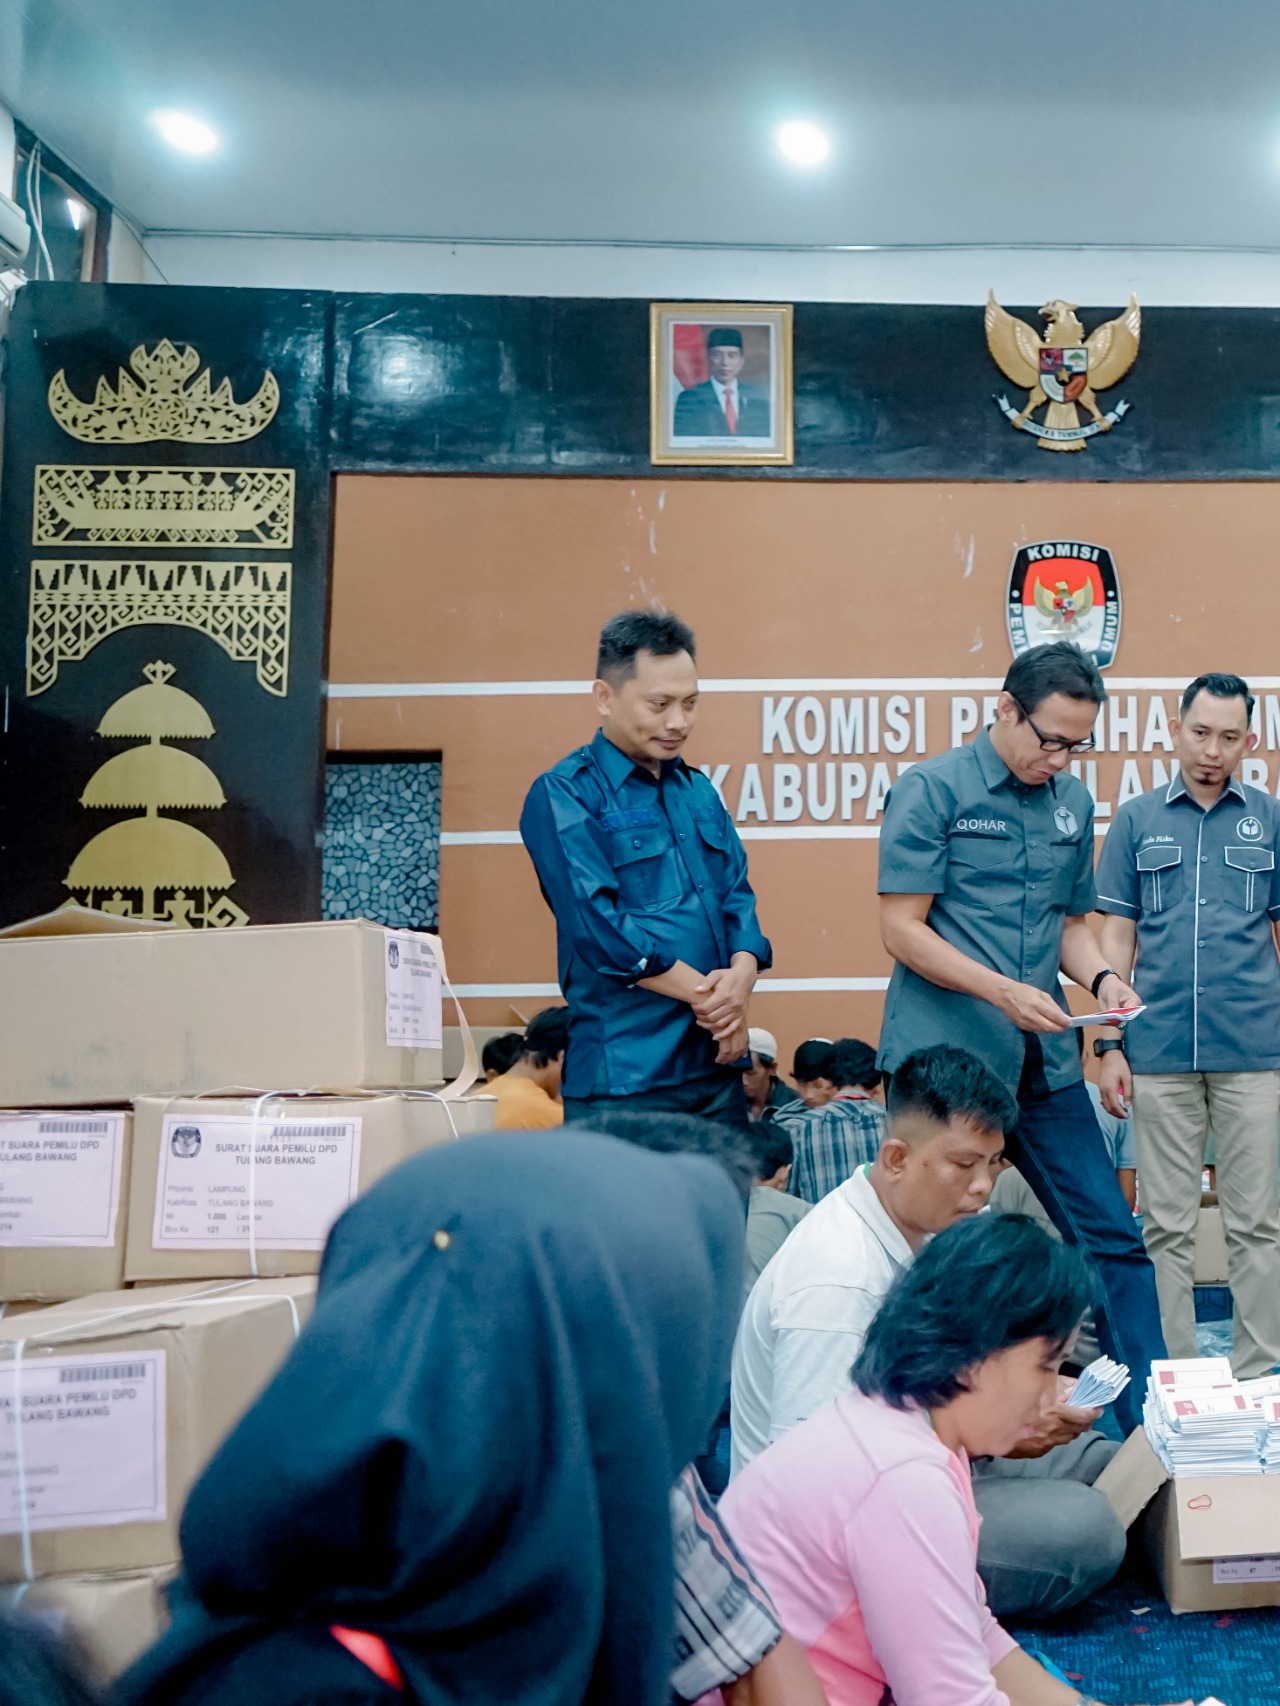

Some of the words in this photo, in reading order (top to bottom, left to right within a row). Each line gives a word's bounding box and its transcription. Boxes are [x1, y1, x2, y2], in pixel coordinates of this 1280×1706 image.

[1027, 544, 1099, 562] KOMISI
[1101, 601, 1118, 652] UMUM
[762, 695, 926, 755] KOMISI
[956, 818, 1006, 832] QOHAR
[8, 1141, 41, 1150] SUARA
[42, 1141, 79, 1150] PEMILU
[80, 1140, 100, 1150] DPD
[215, 1143, 245, 1153] SURAT
[282, 1144, 316, 1154] PEMILU
[318, 1144, 338, 1154] DPD
[34, 1152, 78, 1162] BAWANG
[274, 1156, 316, 1165] BAWANG
[240, 1199, 274, 1208] BAANG
